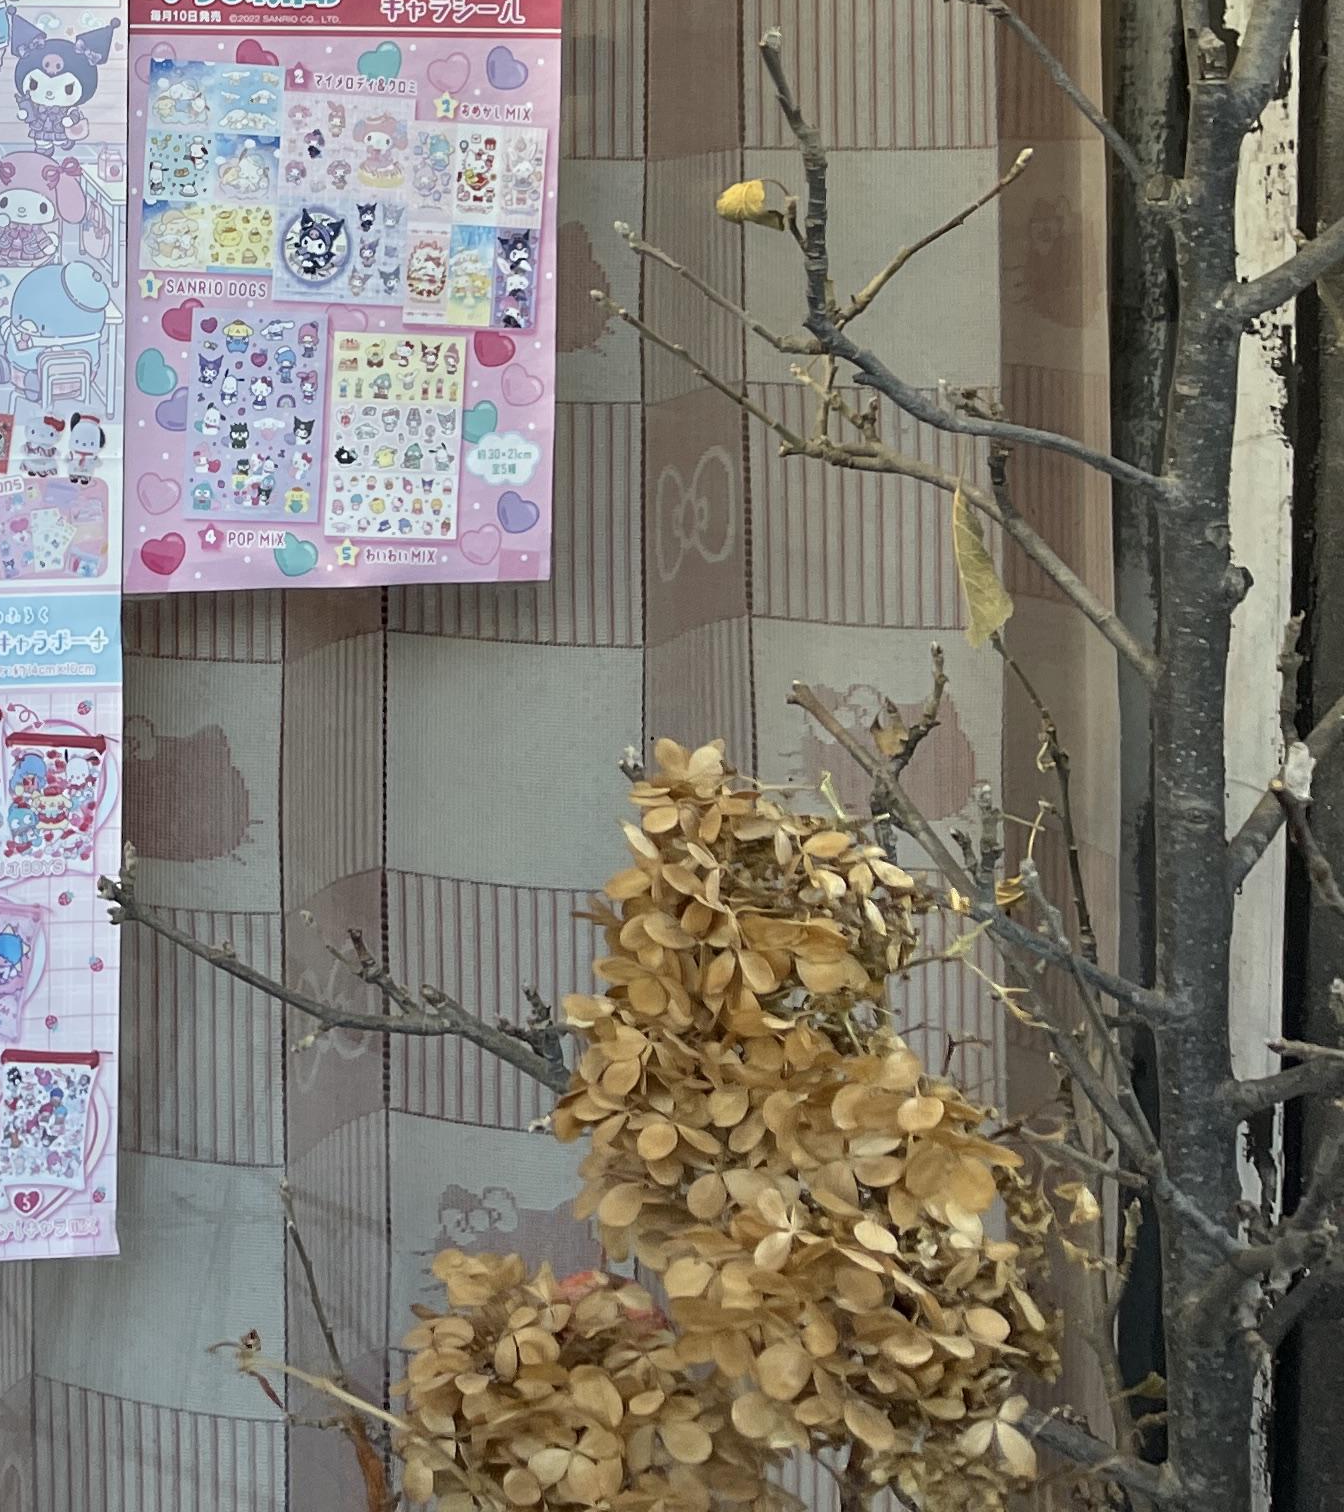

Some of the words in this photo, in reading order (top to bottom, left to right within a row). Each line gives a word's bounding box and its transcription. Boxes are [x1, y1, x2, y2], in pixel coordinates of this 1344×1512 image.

[150, 10, 222, 24] 毎月10日発売
[313, 73, 418, 95] マイメロディ&クロミ
[166, 278, 224, 296] SANRIO
[228, 281, 268, 297] DOGS
[226, 530, 255, 547] POP
[258, 531, 287, 548] MIX
[341, 546, 353, 561] 5
